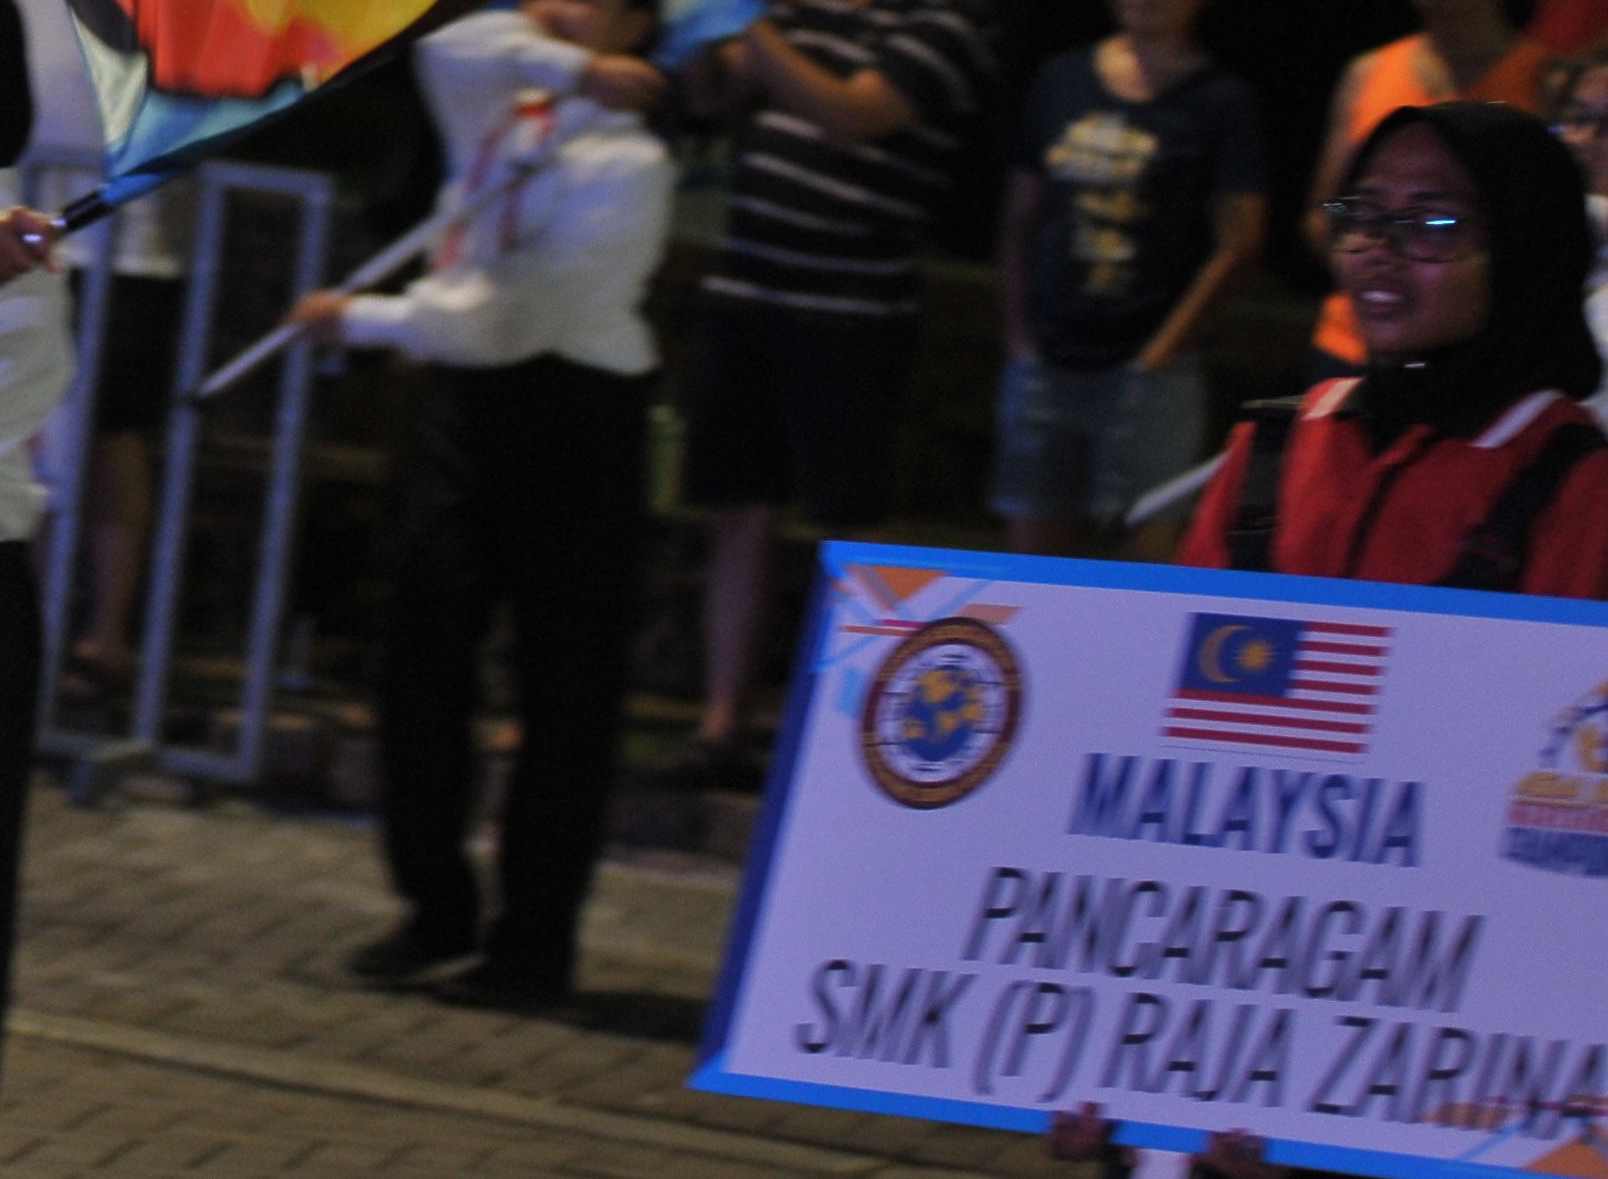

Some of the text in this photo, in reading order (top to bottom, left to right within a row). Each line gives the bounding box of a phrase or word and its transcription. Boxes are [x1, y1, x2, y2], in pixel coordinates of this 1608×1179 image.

[1066, 752, 1424, 867] MALAYSIA
[961, 866, 1485, 1013] PANCARAGAM
[797, 958, 1608, 1141] SMK (P) RAJA ZARINA
